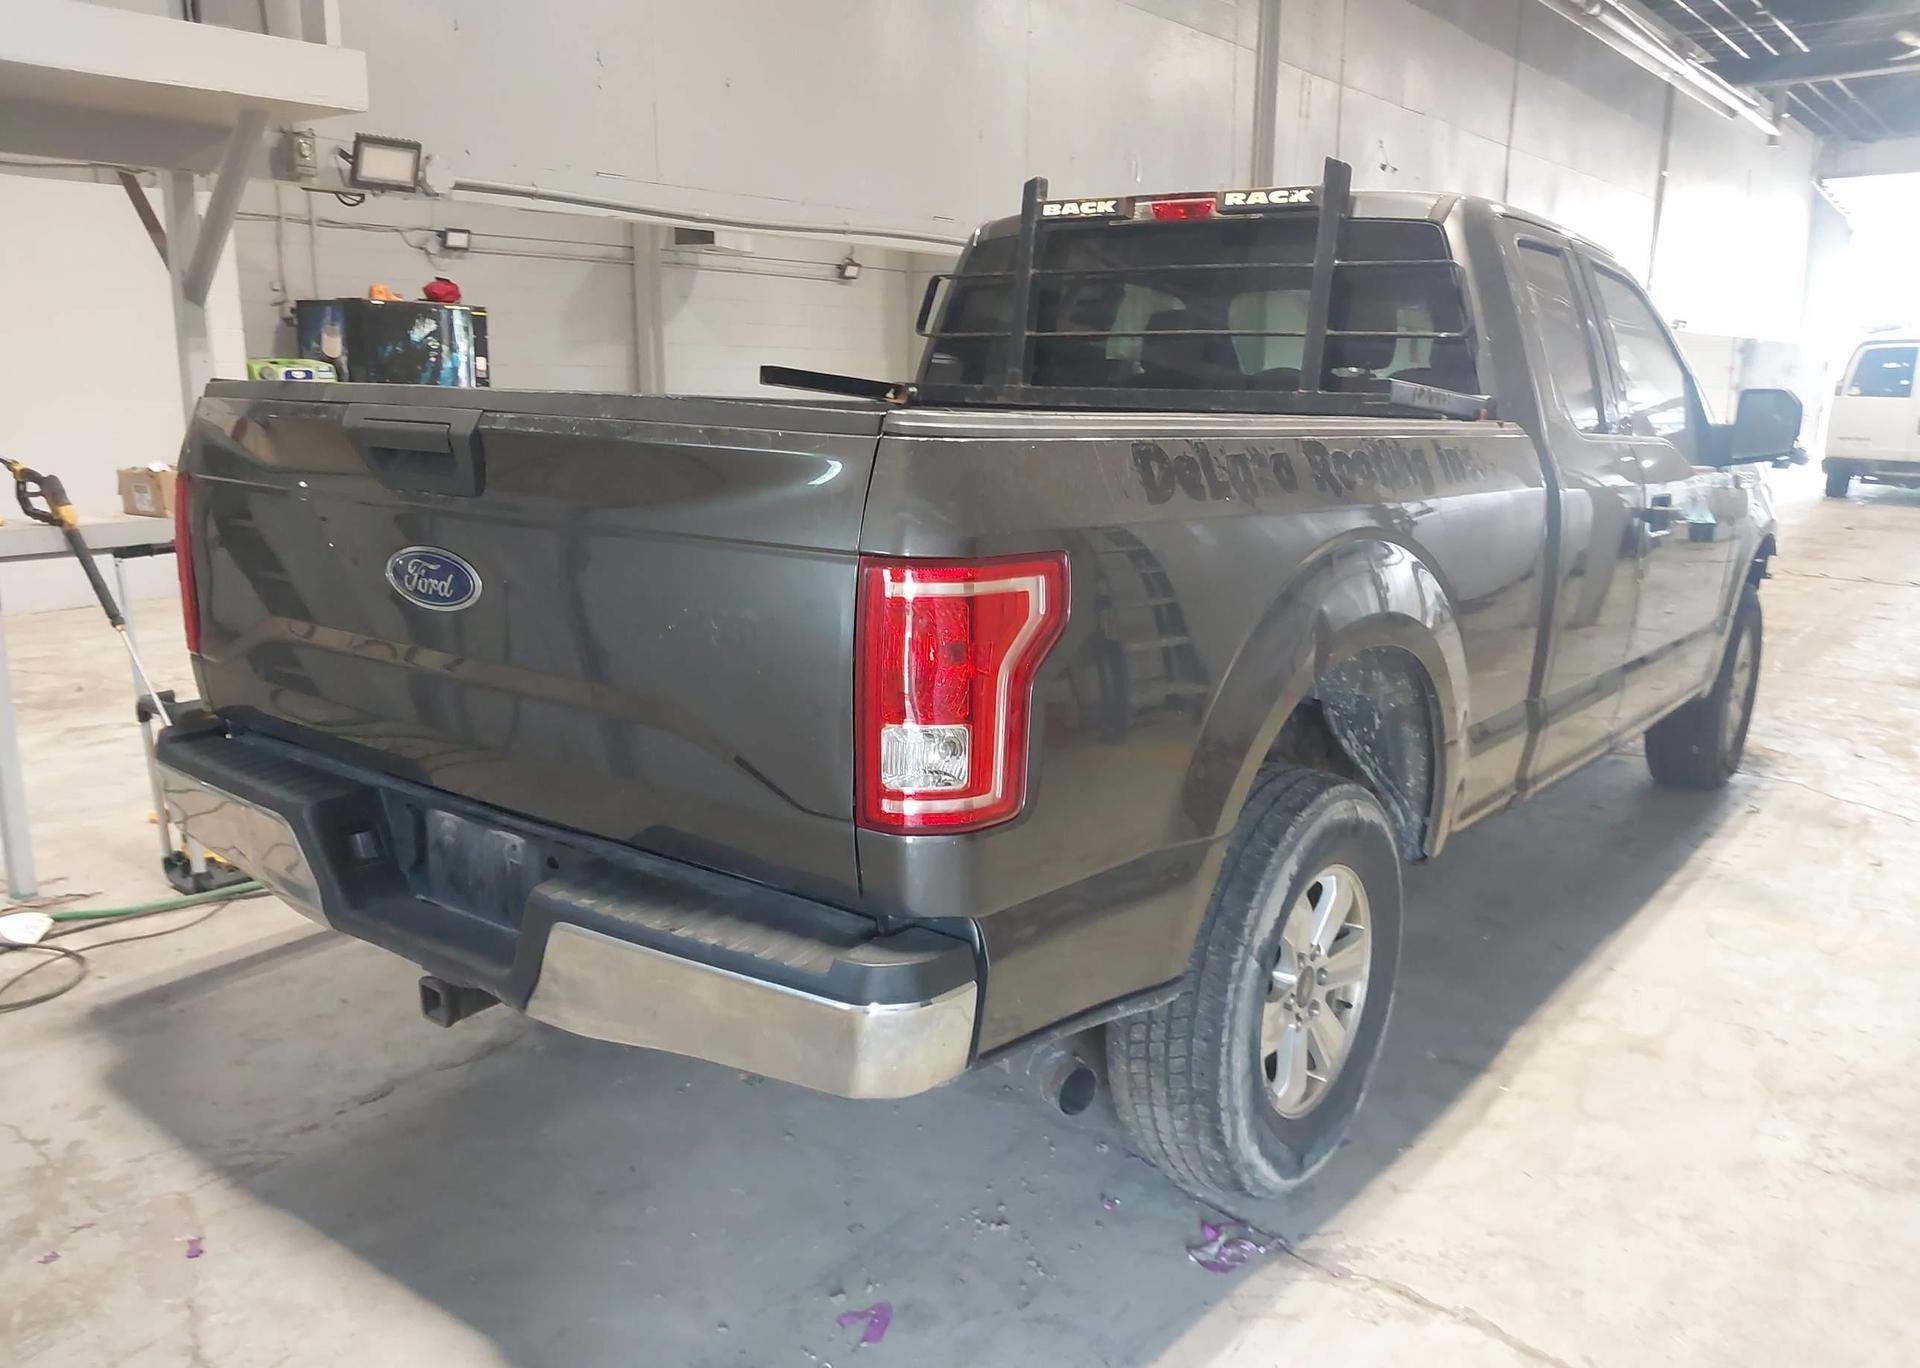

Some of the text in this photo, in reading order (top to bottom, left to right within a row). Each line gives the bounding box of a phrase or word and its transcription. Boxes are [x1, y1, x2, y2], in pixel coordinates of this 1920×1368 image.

[1042, 189, 1314, 217] BACK RACK
[404, 558, 454, 598] Ford
